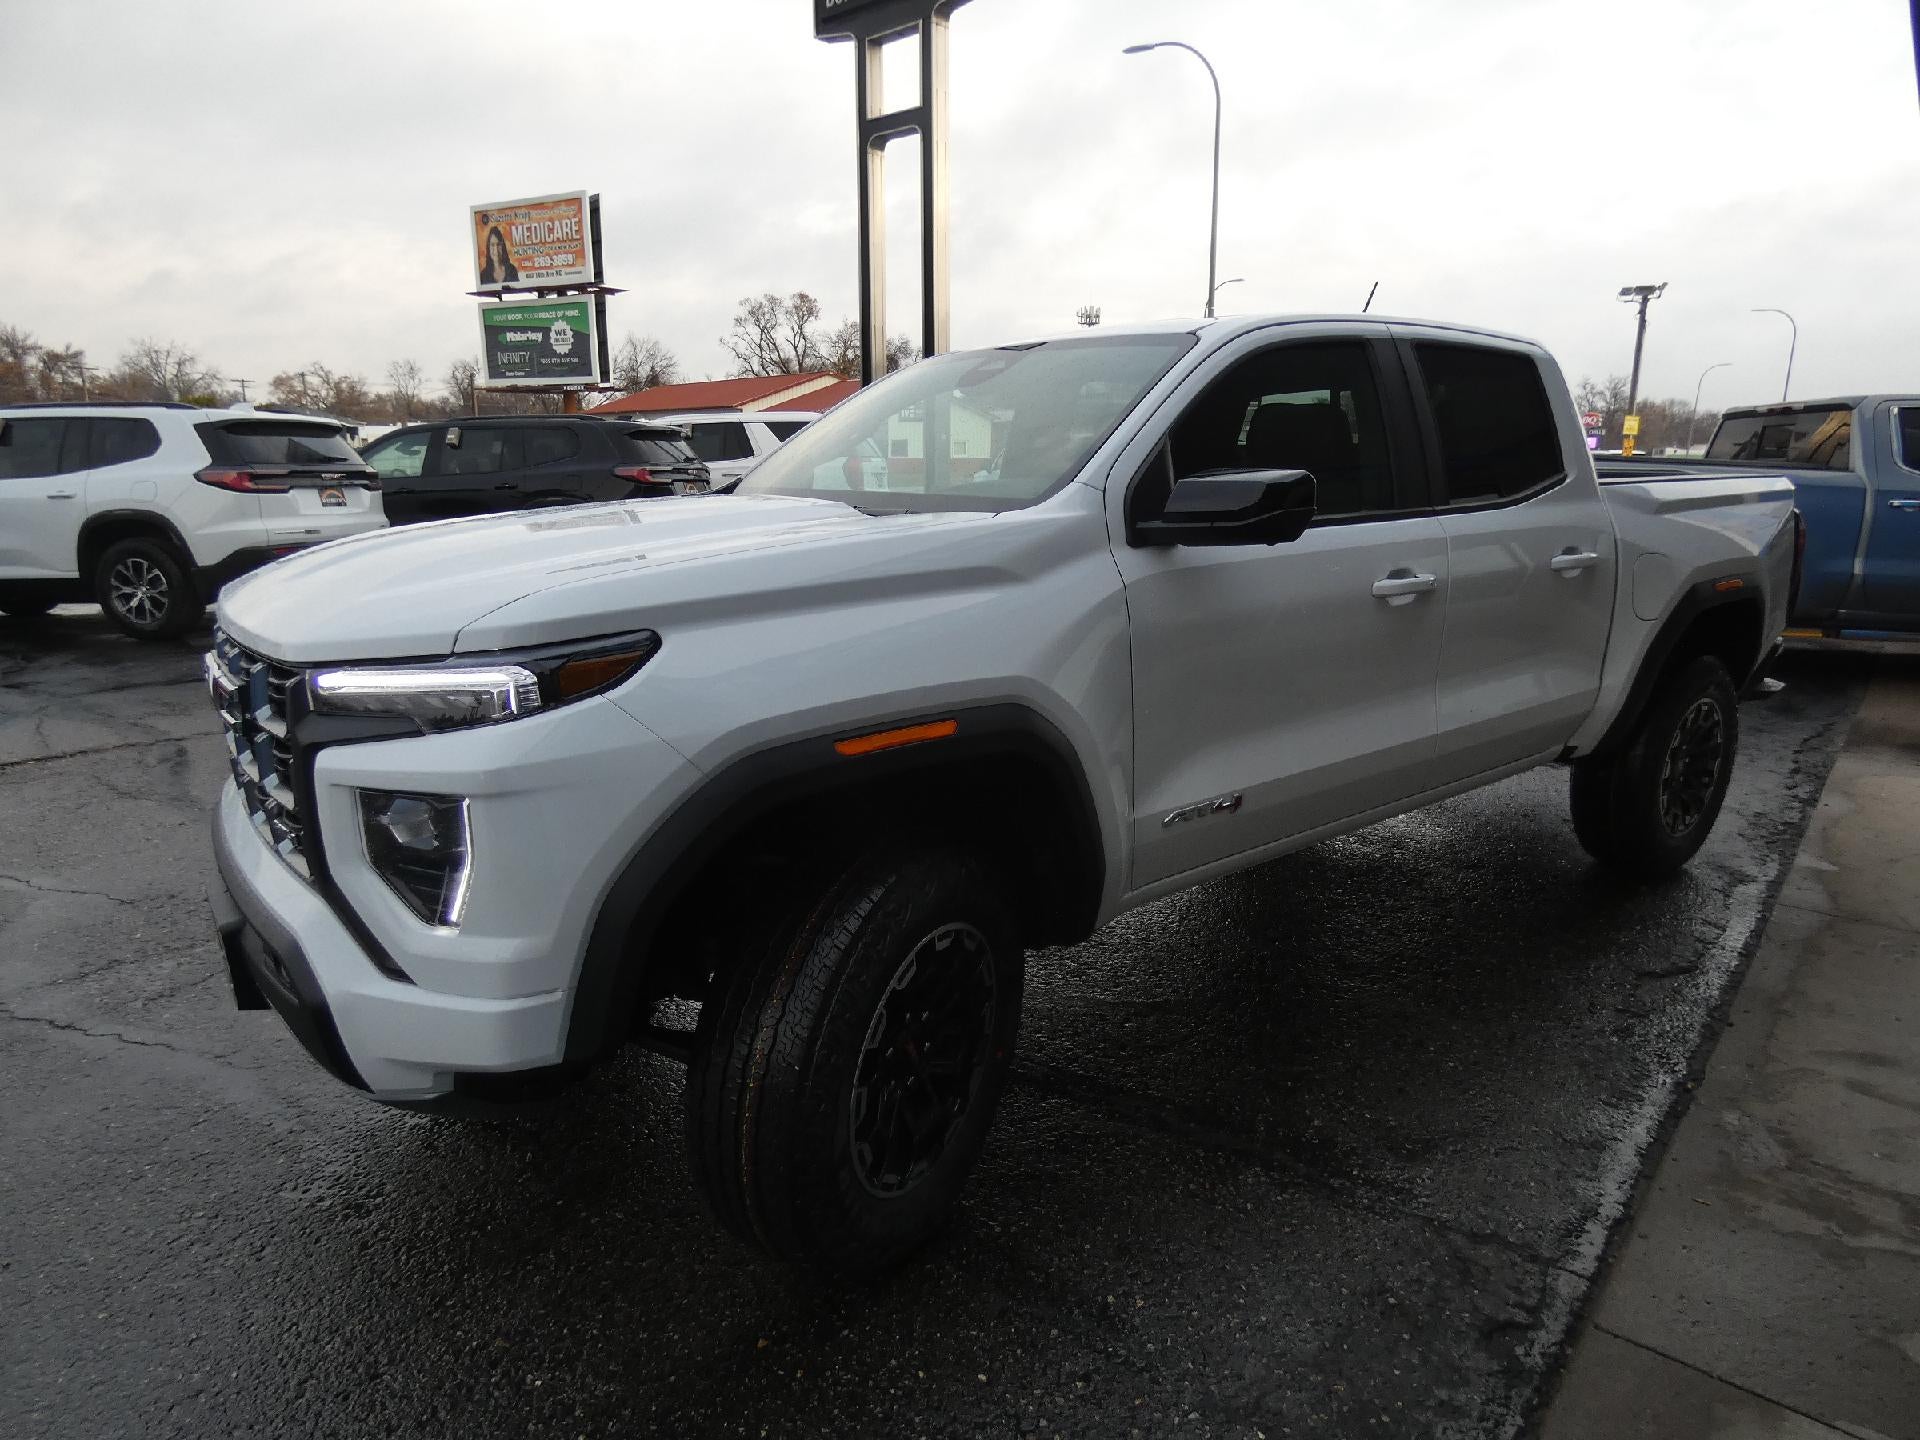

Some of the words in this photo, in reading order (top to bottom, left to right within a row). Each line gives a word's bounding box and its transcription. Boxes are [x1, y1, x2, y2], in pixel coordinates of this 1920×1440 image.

[511, 217, 580, 246] MEDICARE
[554, 328, 567, 336] WE
[1161, 792, 1242, 829] AT4
